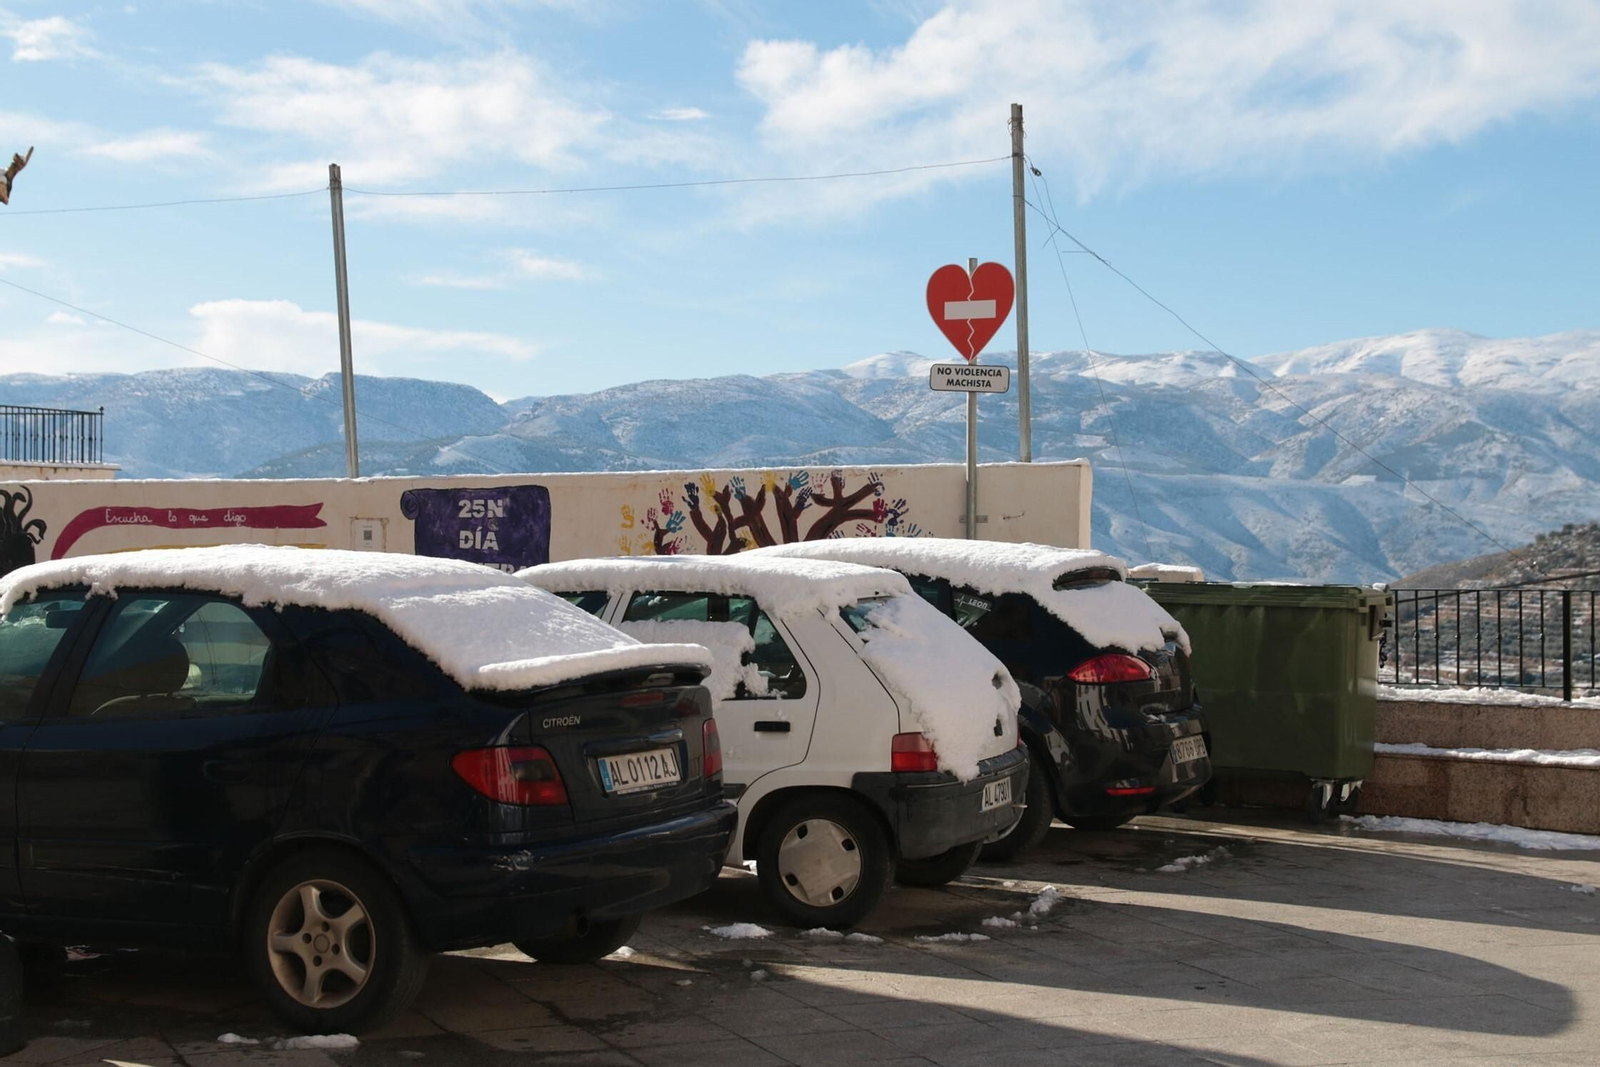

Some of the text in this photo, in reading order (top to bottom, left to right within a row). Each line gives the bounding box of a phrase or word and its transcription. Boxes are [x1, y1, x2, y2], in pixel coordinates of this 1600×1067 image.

[937, 367, 1002, 377] NO VIOLENCIA
[946, 379, 991, 388] MACHISTA
[105, 508, 246, 527] Escucha lo que digo
[458, 499, 503, 518] 25N
[459, 526, 499, 551] DÍA
[609, 752, 677, 787] AL 0112 AJ
